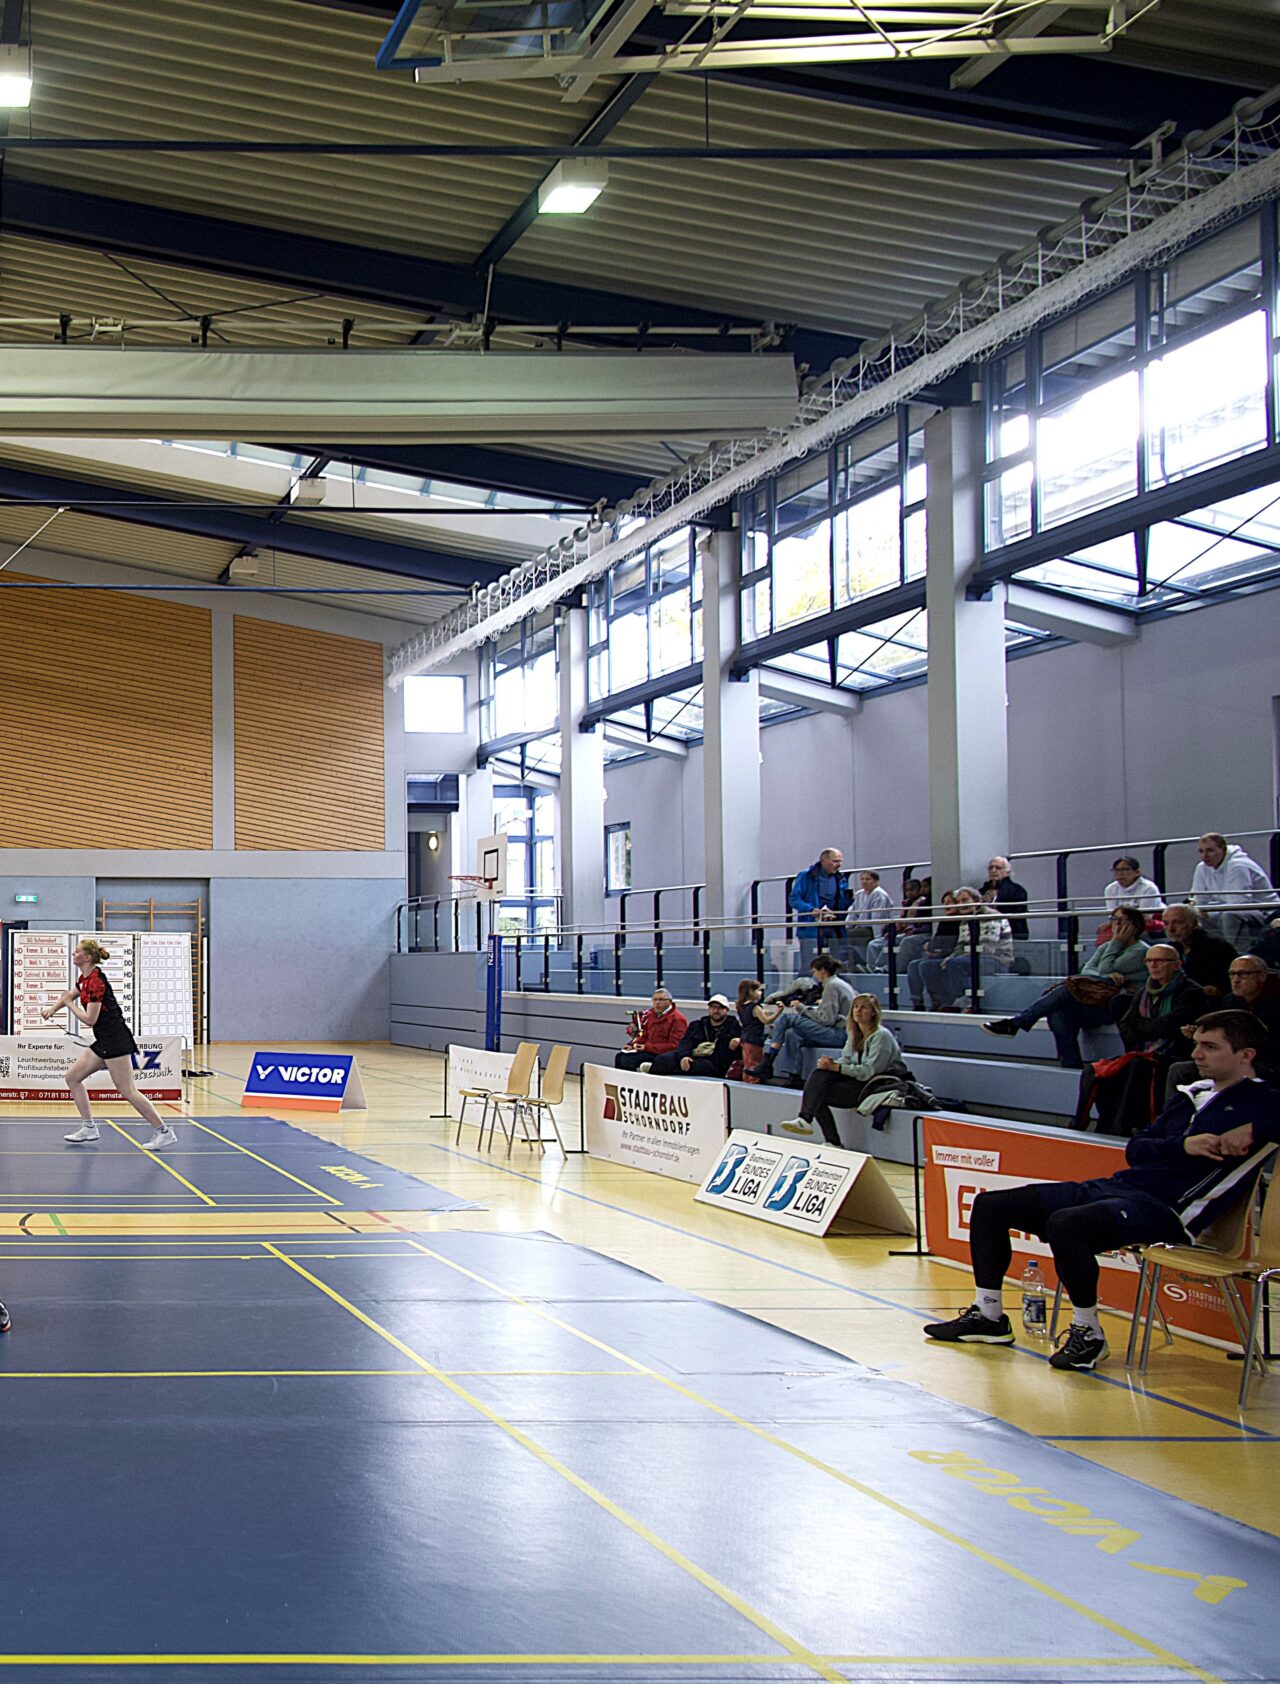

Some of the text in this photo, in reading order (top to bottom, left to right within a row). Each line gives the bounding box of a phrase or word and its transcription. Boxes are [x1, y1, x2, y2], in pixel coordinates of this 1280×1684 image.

[28, 1043, 52, 1051] Experte
[278, 1065, 345, 1084] VICTOR
[620, 1086, 689, 1118] STADTBAU
[623, 1110, 691, 1136] SCHORNDORF
[749, 1152, 777, 1166] Badminton
[935, 1149, 996, 1168] Immer mit voller
[742, 1163, 772, 1179] BUNDES
[811, 1167, 843, 1181] Badminton
[731, 1175, 762, 1199] LIGA
[804, 1178, 838, 1195] BUNDES
[793, 1191, 827, 1216] LIGA
